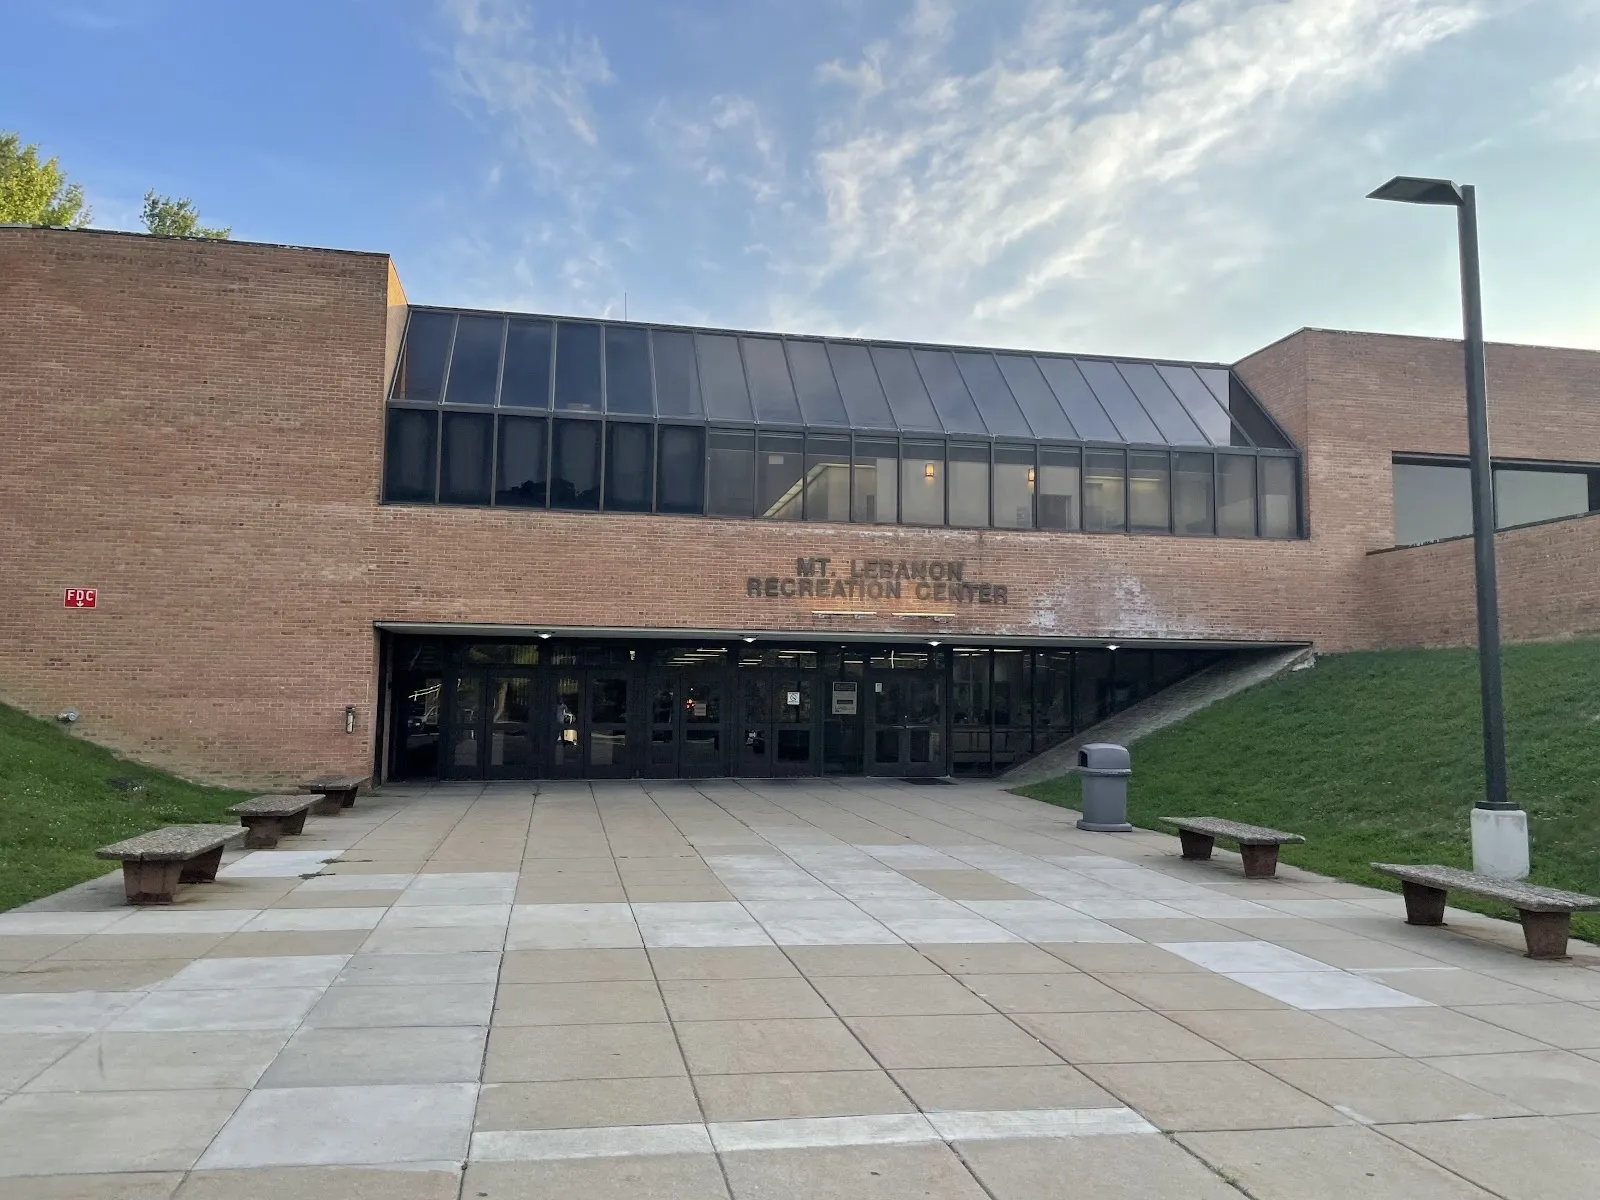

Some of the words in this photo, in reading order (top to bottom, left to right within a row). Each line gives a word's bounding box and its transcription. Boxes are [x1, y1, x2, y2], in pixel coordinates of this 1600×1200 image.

[796, 557, 836, 578] MT.
[850, 559, 965, 581] LEBANON
[67, 590, 93, 601] FDC
[747, 577, 901, 599] RECREATION
[916, 581, 1008, 604] CENTER
